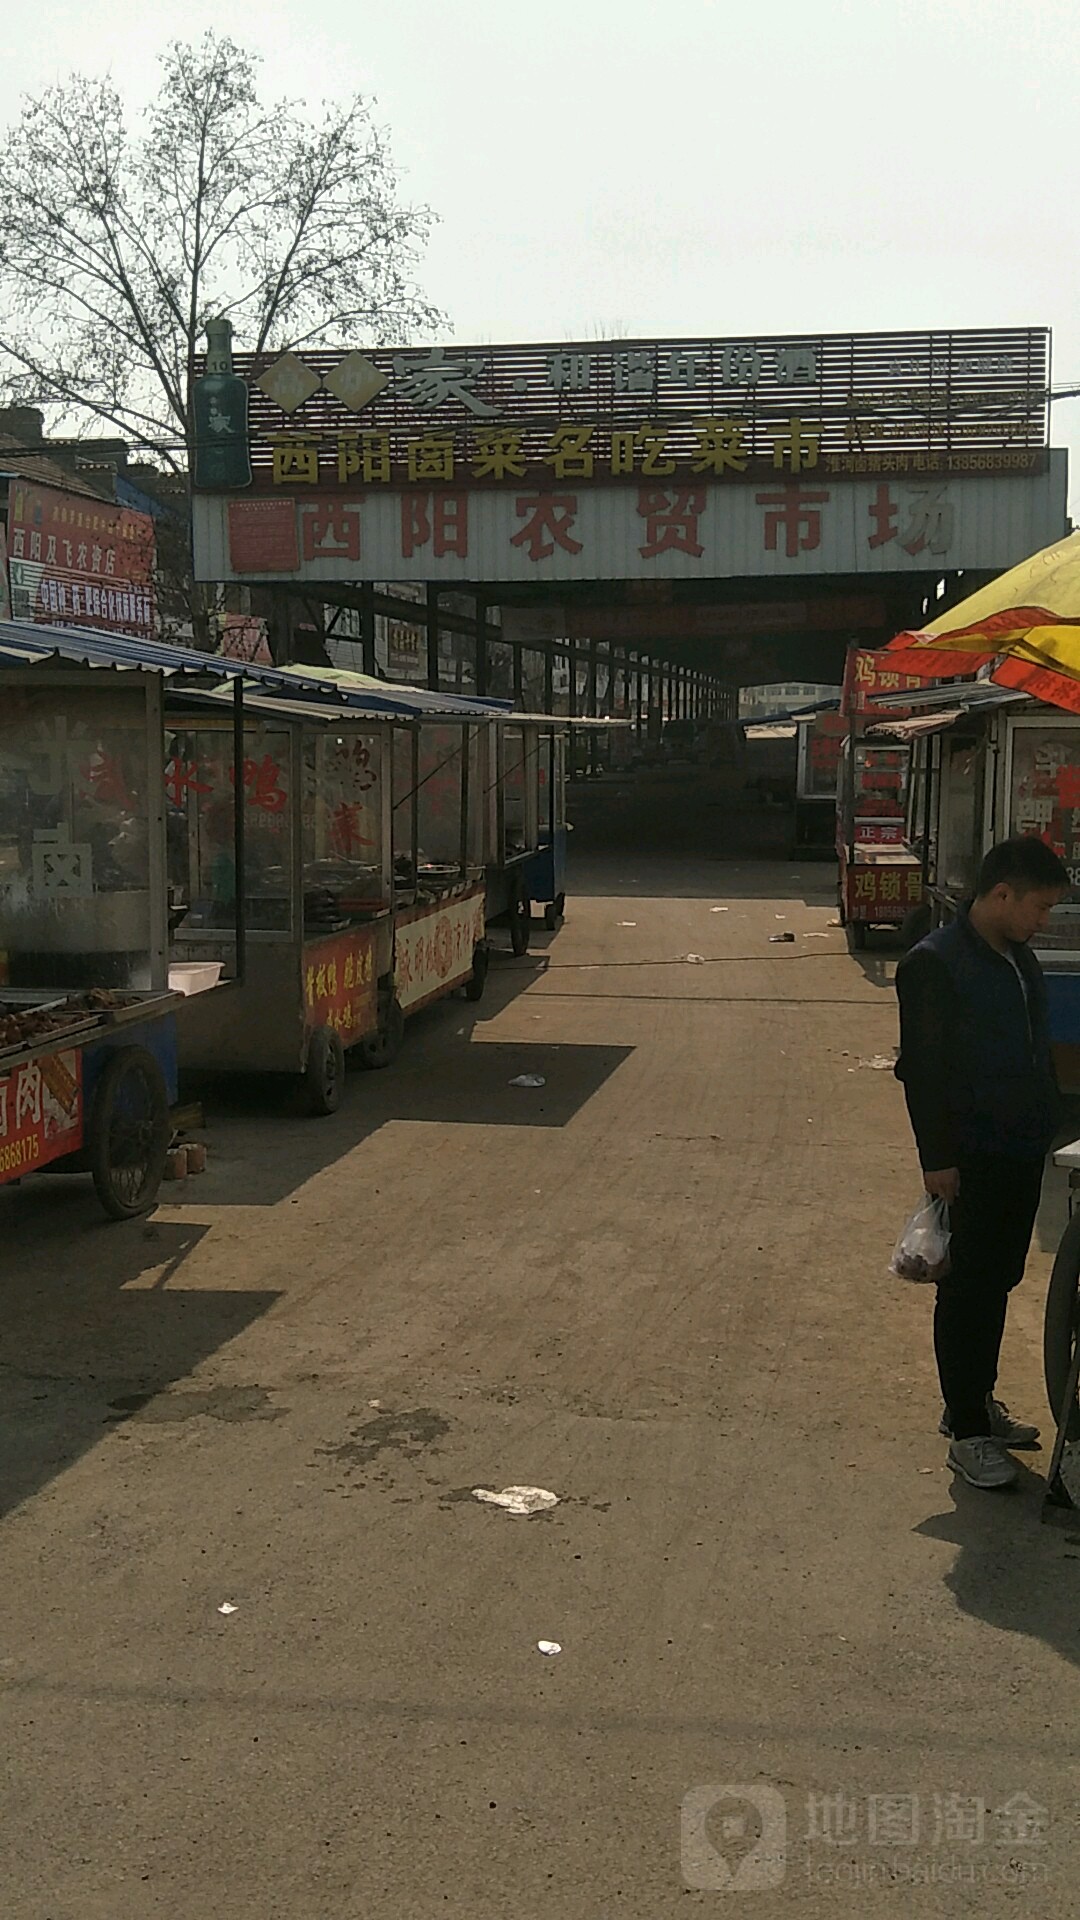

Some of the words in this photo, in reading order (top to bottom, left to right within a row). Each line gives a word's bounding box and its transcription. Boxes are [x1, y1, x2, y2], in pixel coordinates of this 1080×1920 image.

[297, 483, 955, 561] 西阳农贸市场
[859, 825, 898, 840] 正宗
[855, 871, 923, 902] 鸡锁骨
